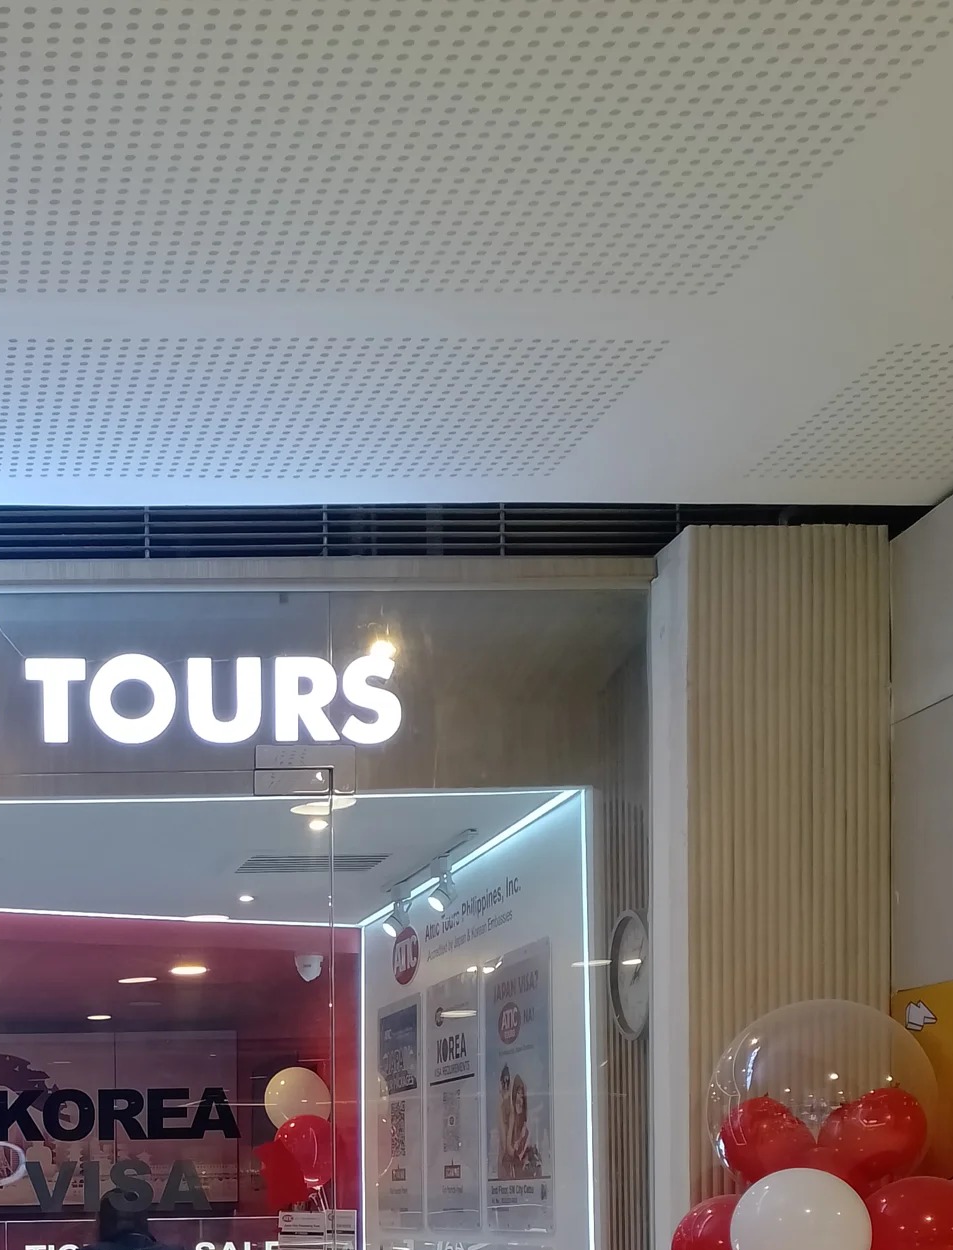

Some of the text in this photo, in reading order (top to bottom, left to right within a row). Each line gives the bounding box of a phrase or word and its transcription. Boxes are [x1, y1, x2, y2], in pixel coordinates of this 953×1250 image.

[24, 653, 403, 745] TOURS
[461, 886, 504, 923] Philippines,
[506, 876, 521, 898] Inc.
[436, 1032, 467, 1064] KOREA
[26, 1159, 213, 1213] VISA
